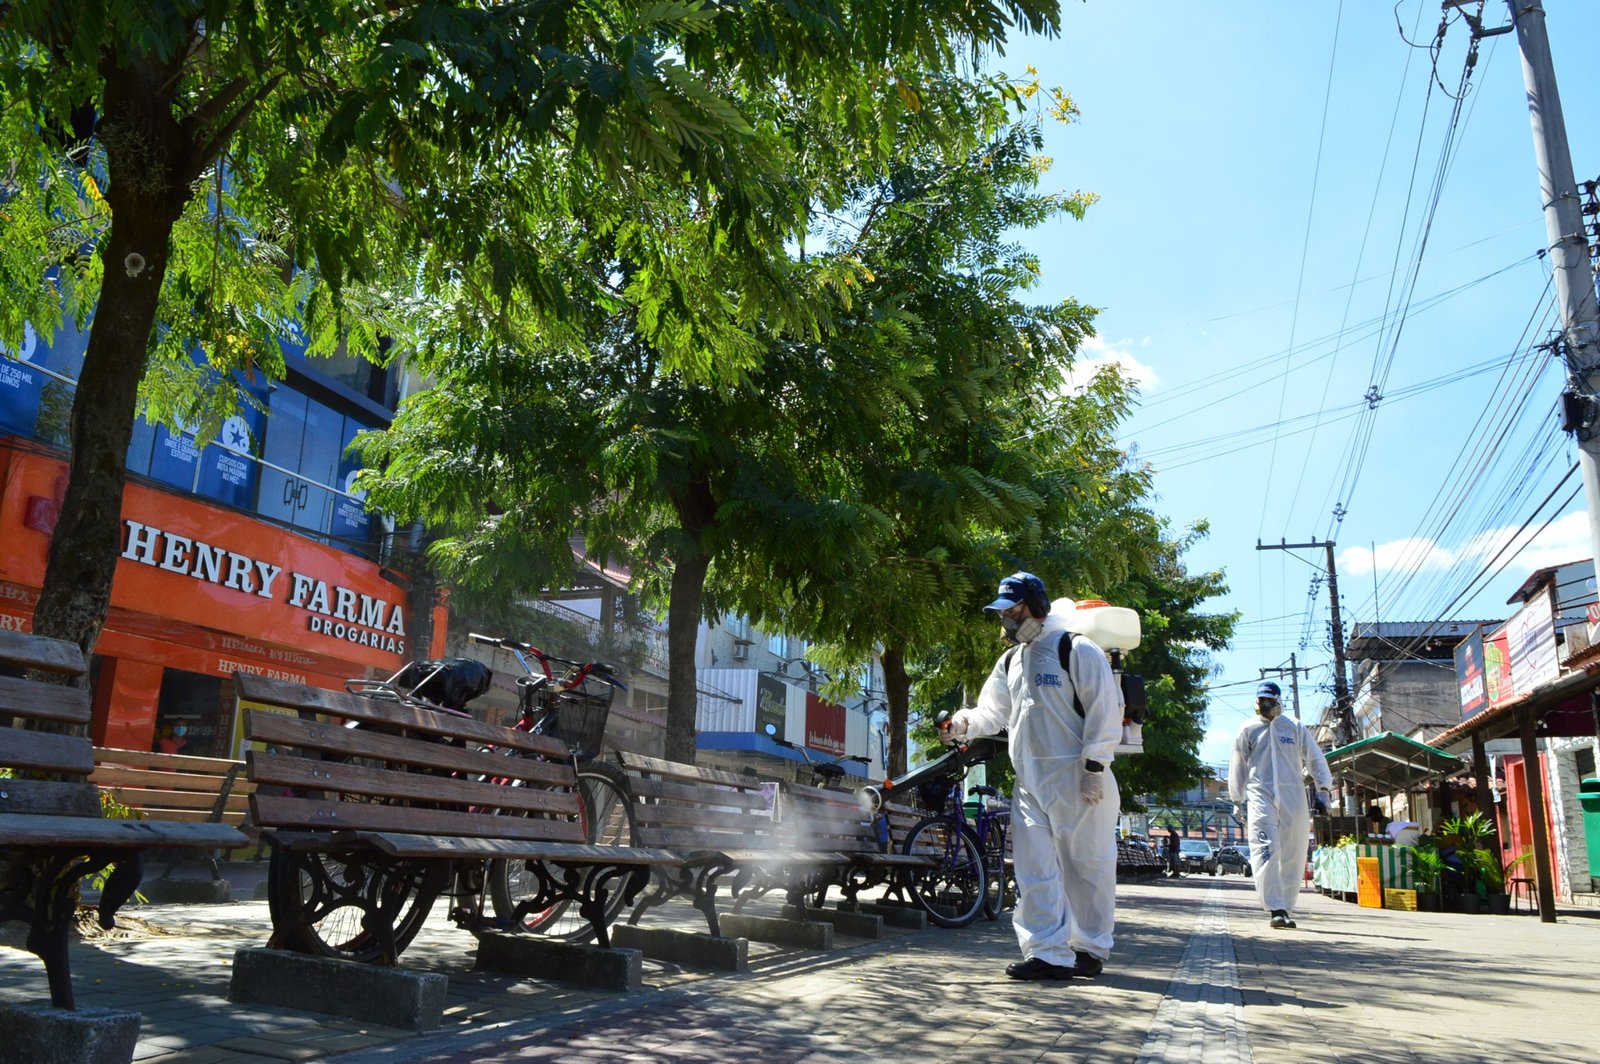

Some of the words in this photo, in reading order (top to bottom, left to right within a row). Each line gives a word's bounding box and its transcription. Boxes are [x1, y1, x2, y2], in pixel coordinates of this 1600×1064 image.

[1, 364, 10, 375] DE
[10, 368, 21, 380] 250
[22, 372, 32, 385] MIL
[217, 462, 229, 473] NOTA
[219, 454, 237, 468] CURSOS
[236, 461, 247, 471] COM
[222, 472, 229, 481] NO
[229, 475, 239, 485] MEC
[121, 519, 282, 599] HENRY
[288, 571, 406, 637] FARMA
[310, 615, 405, 655] DROGARIAS
[217, 659, 264, 677] HENRY
[267, 668, 307, 685] FARMA
